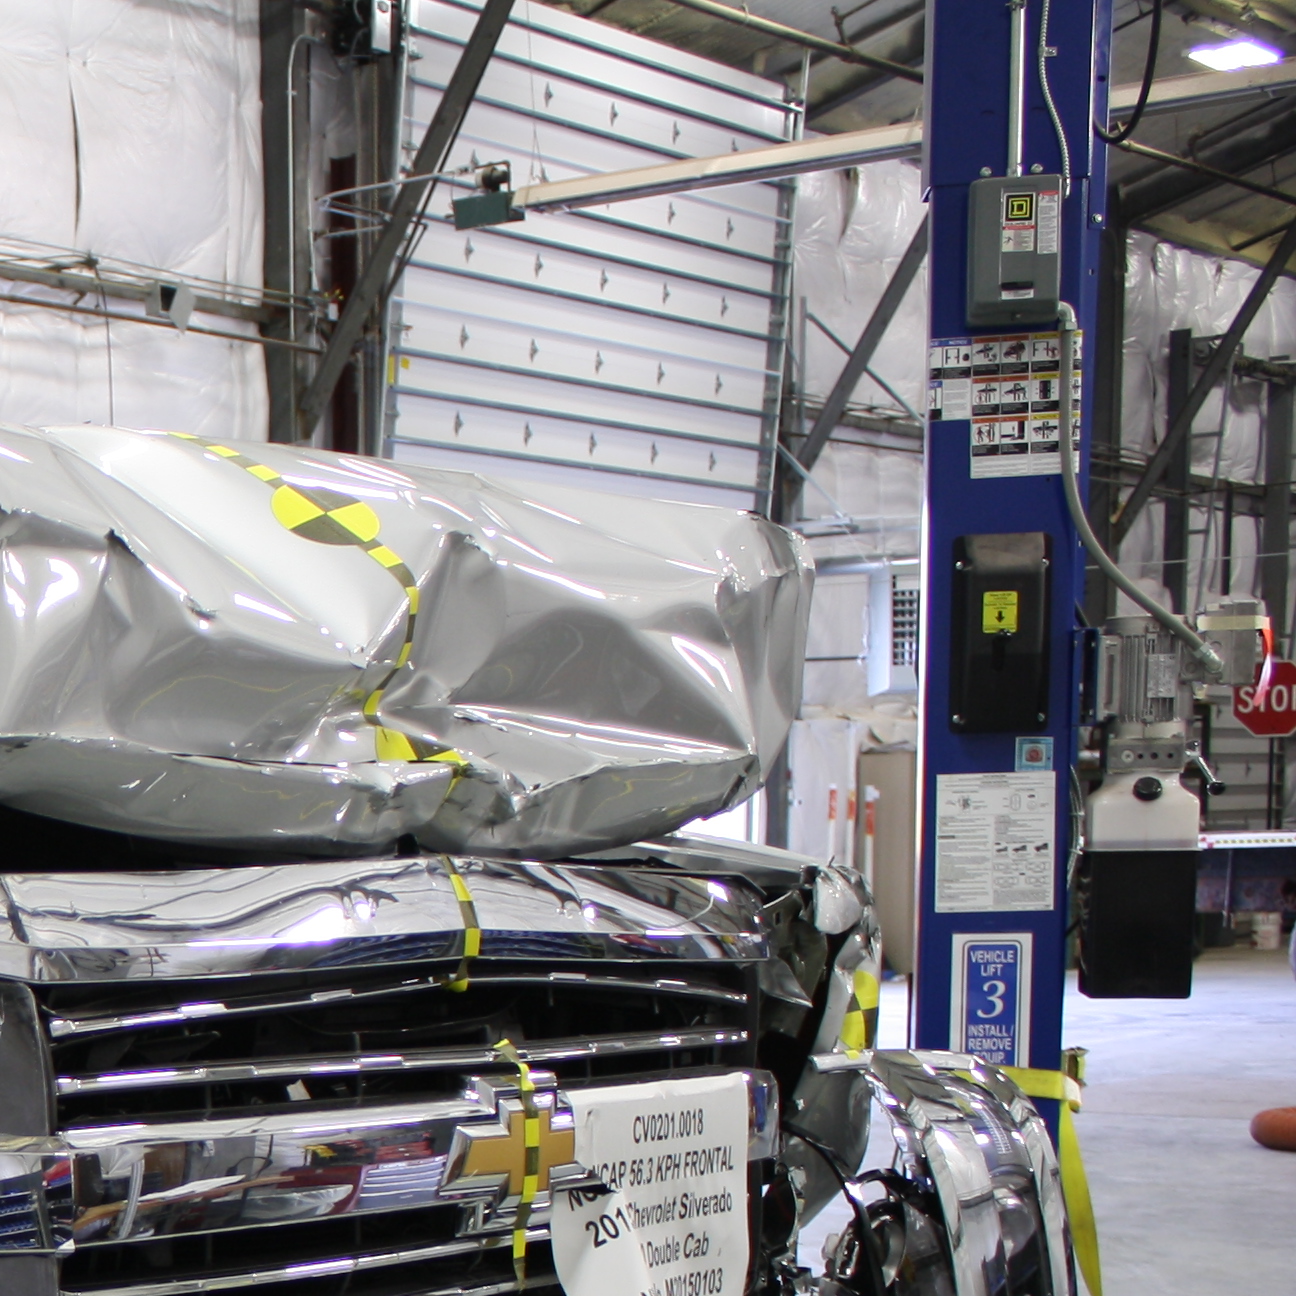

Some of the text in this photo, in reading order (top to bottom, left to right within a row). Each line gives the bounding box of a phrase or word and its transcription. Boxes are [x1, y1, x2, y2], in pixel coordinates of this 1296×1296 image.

[1237, 684, 1296, 714] SO
[970, 950, 1015, 963] VEHICLE
[980, 964, 1004, 977] LIFT
[976, 980, 1007, 1019] 3
[968, 1024, 1009, 1037] INSTALL
[968, 1038, 1012, 1051] REMOVE
[973, 1051, 1006, 1064] QUIP.
[633, 1108, 704, 1144] CV0201.0018
[628, 1157, 653, 1187] 56.3
[656, 1152, 681, 1183] KPH
[684, 1145, 734, 1179] FRONTAL
[679, 1187, 733, 1220] Silverado
[646, 1235, 680, 1268] Double
[683, 1231, 709, 1259] Cab
